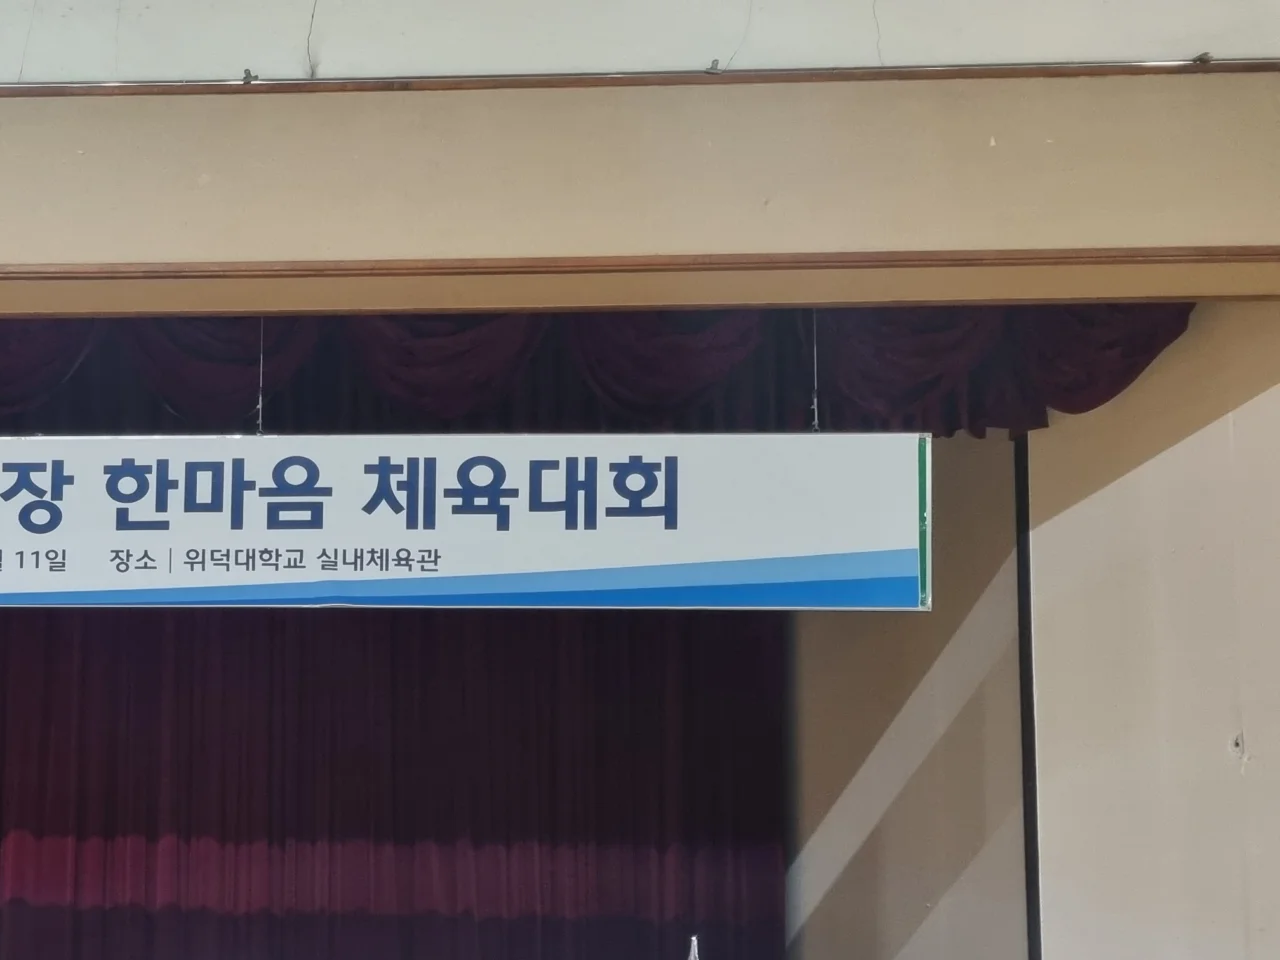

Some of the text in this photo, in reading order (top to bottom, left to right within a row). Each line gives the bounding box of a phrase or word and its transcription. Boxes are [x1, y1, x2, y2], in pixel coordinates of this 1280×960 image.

[103, 455, 333, 531] 한마음
[361, 455, 679, 532] 체육대회
[14, 548, 68, 573] 11일
[109, 548, 158, 574] 장소
[183, 548, 307, 573] 위덕대학교
[316, 548, 443, 573] 실내체육관
